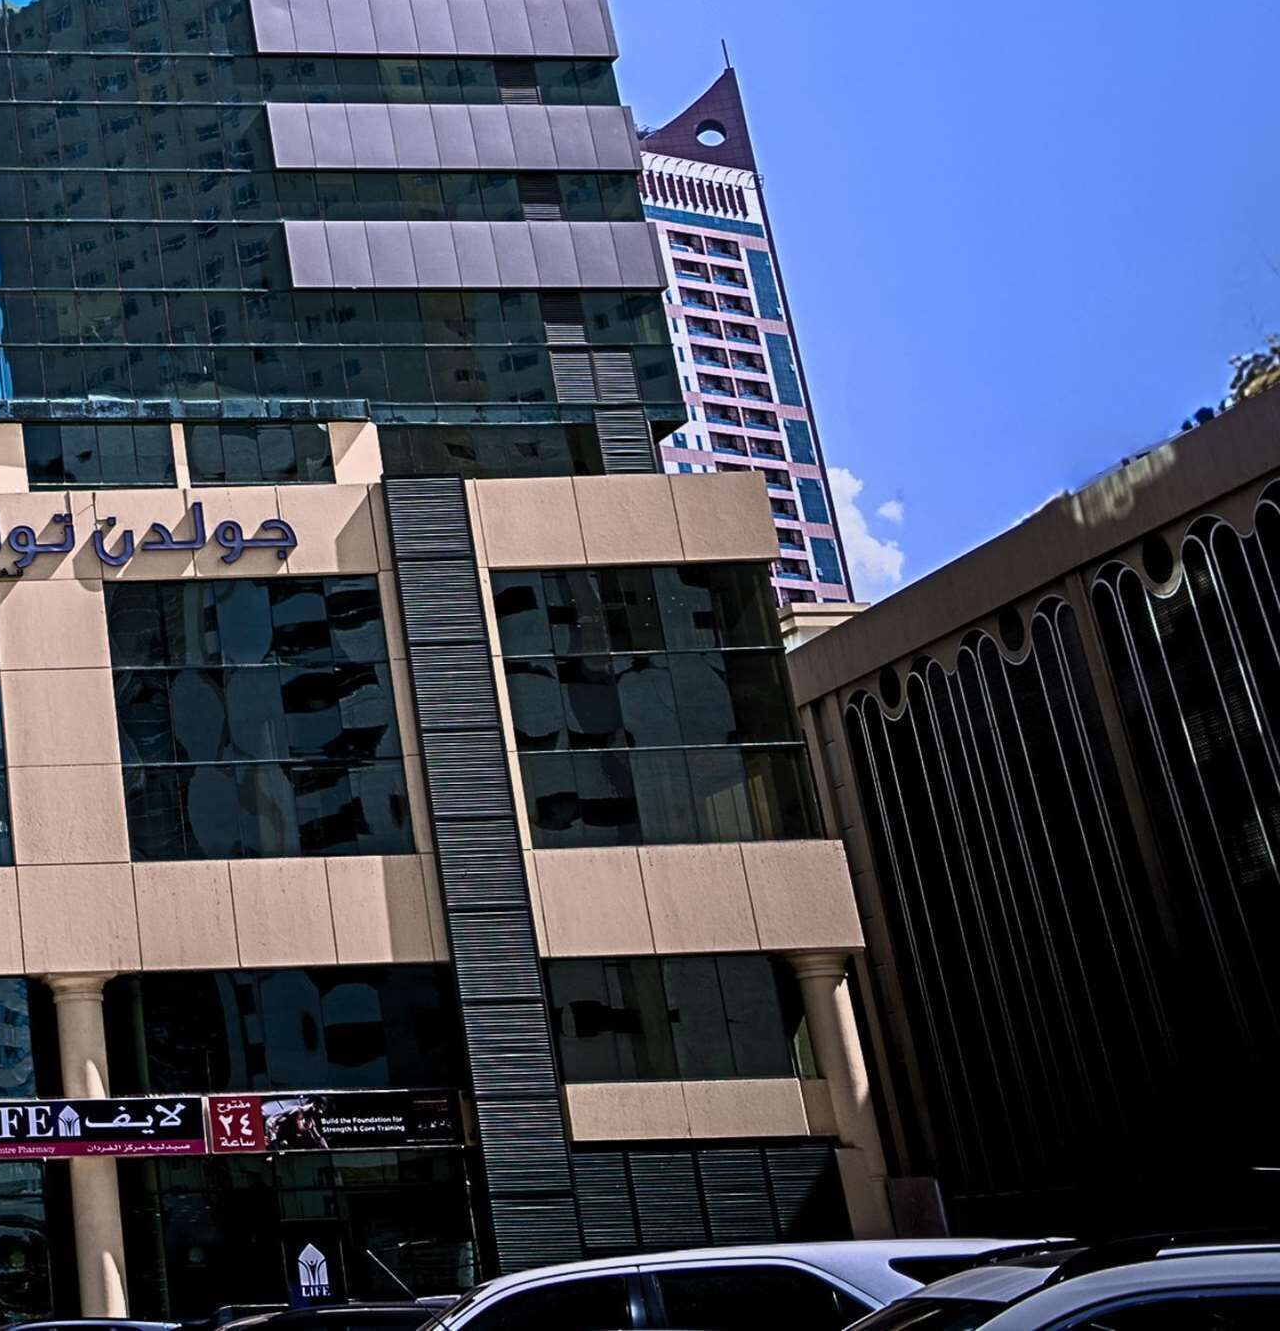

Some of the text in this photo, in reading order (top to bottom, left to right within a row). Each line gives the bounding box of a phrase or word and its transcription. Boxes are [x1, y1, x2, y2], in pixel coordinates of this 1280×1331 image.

[93, 502, 298, 567] جولدن
[216, 1100, 251, 1114] مفتوح
[84, 1102, 186, 1134] لايف
[321, 1117, 339, 1125] Build
[352, 1116, 392, 1124] Foundation
[218, 1113, 254, 1137] ٢٤
[322, 1125, 352, 1134] Strength
[377, 1125, 406, 1133] Training
[220, 1136, 256, 1147] ساعة
[17, 1145, 55, 1154] Pharmacy
[87, 1142, 191, 1153] صيدلية مركز الفردان
[302, 1286, 331, 1297] LIFE
